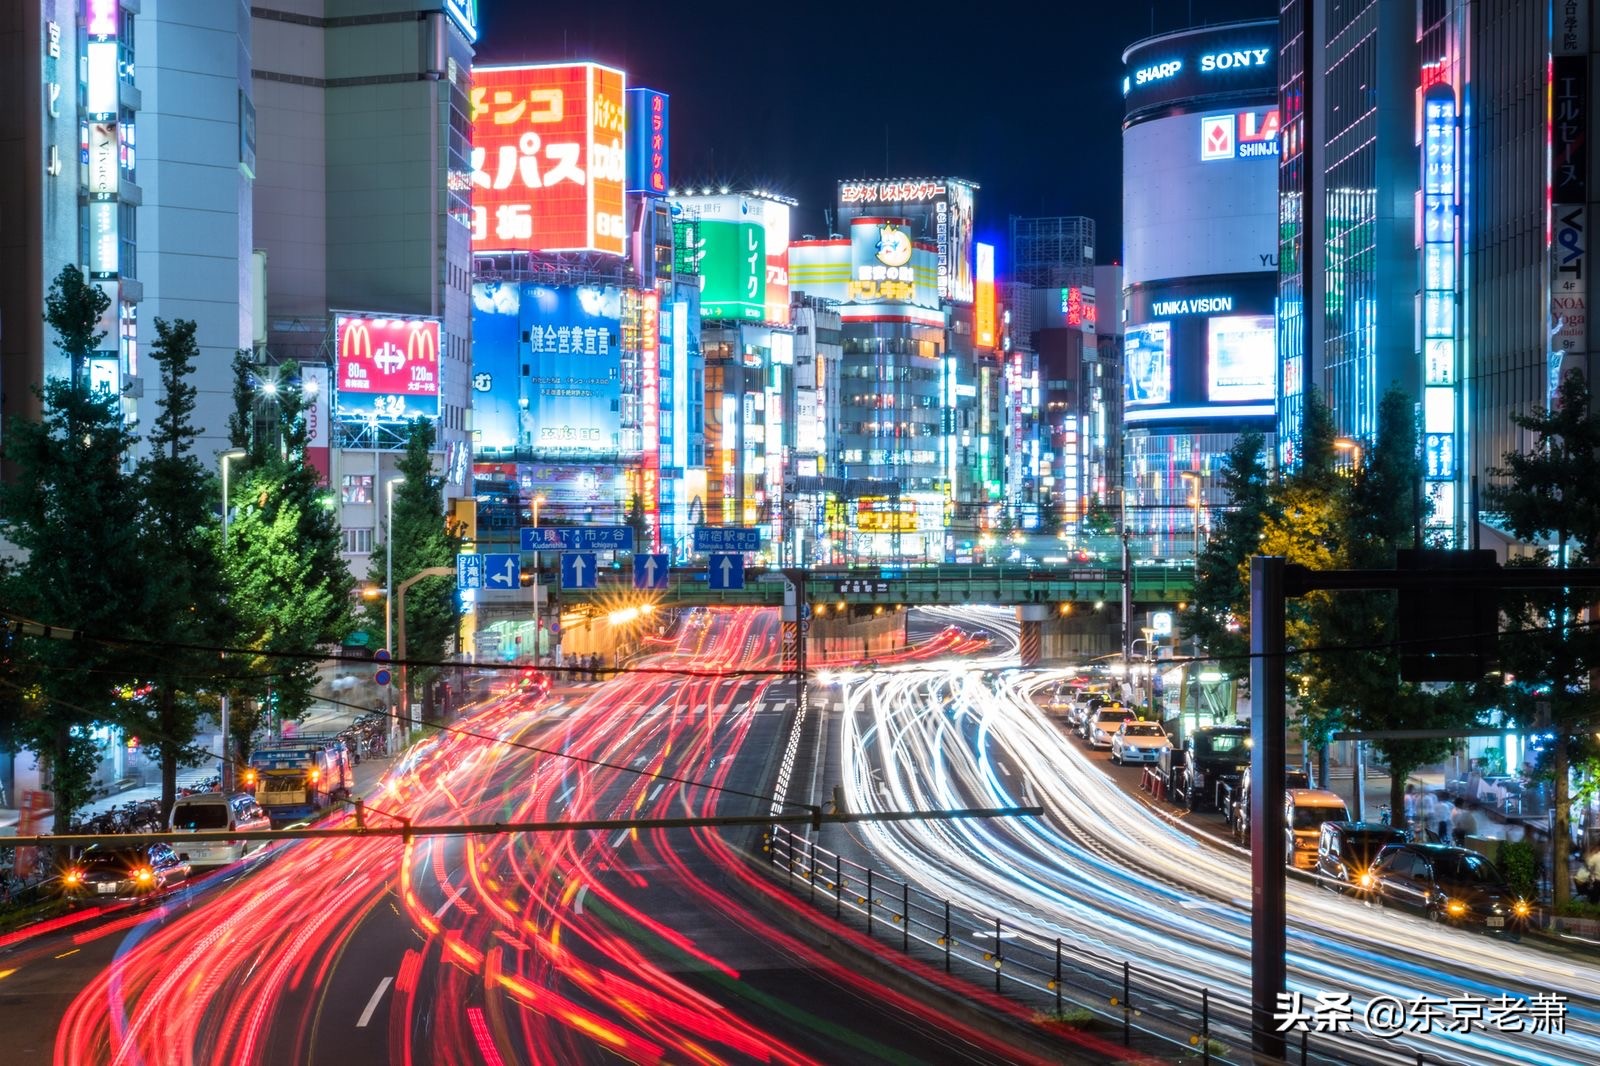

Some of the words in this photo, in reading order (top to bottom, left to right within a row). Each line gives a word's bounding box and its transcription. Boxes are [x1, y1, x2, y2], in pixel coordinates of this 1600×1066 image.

[1201, 48, 1270, 72] SONY
[1135, 60, 1182, 85] SHARP
[1557, 77, 1579, 188] エルセーヌ
[842, 185, 877, 203] エンタメ
[879, 182, 946, 202] レストランタワー
[747, 228, 759, 299] レイク
[1562, 281, 1576, 290] 4F
[1152, 299, 1187, 316] YUNIKA
[1190, 297, 1232, 313] VISION
[1552, 297, 1585, 310] NOA
[1552, 312, 1585, 326] Yoga
[530, 324, 610, 356] 健全営業宣言
[1562, 340, 1575, 349] 9F
[348, 363, 367, 379] 80m
[410, 365, 433, 382] 120m
[529, 529, 570, 542] 九段下
